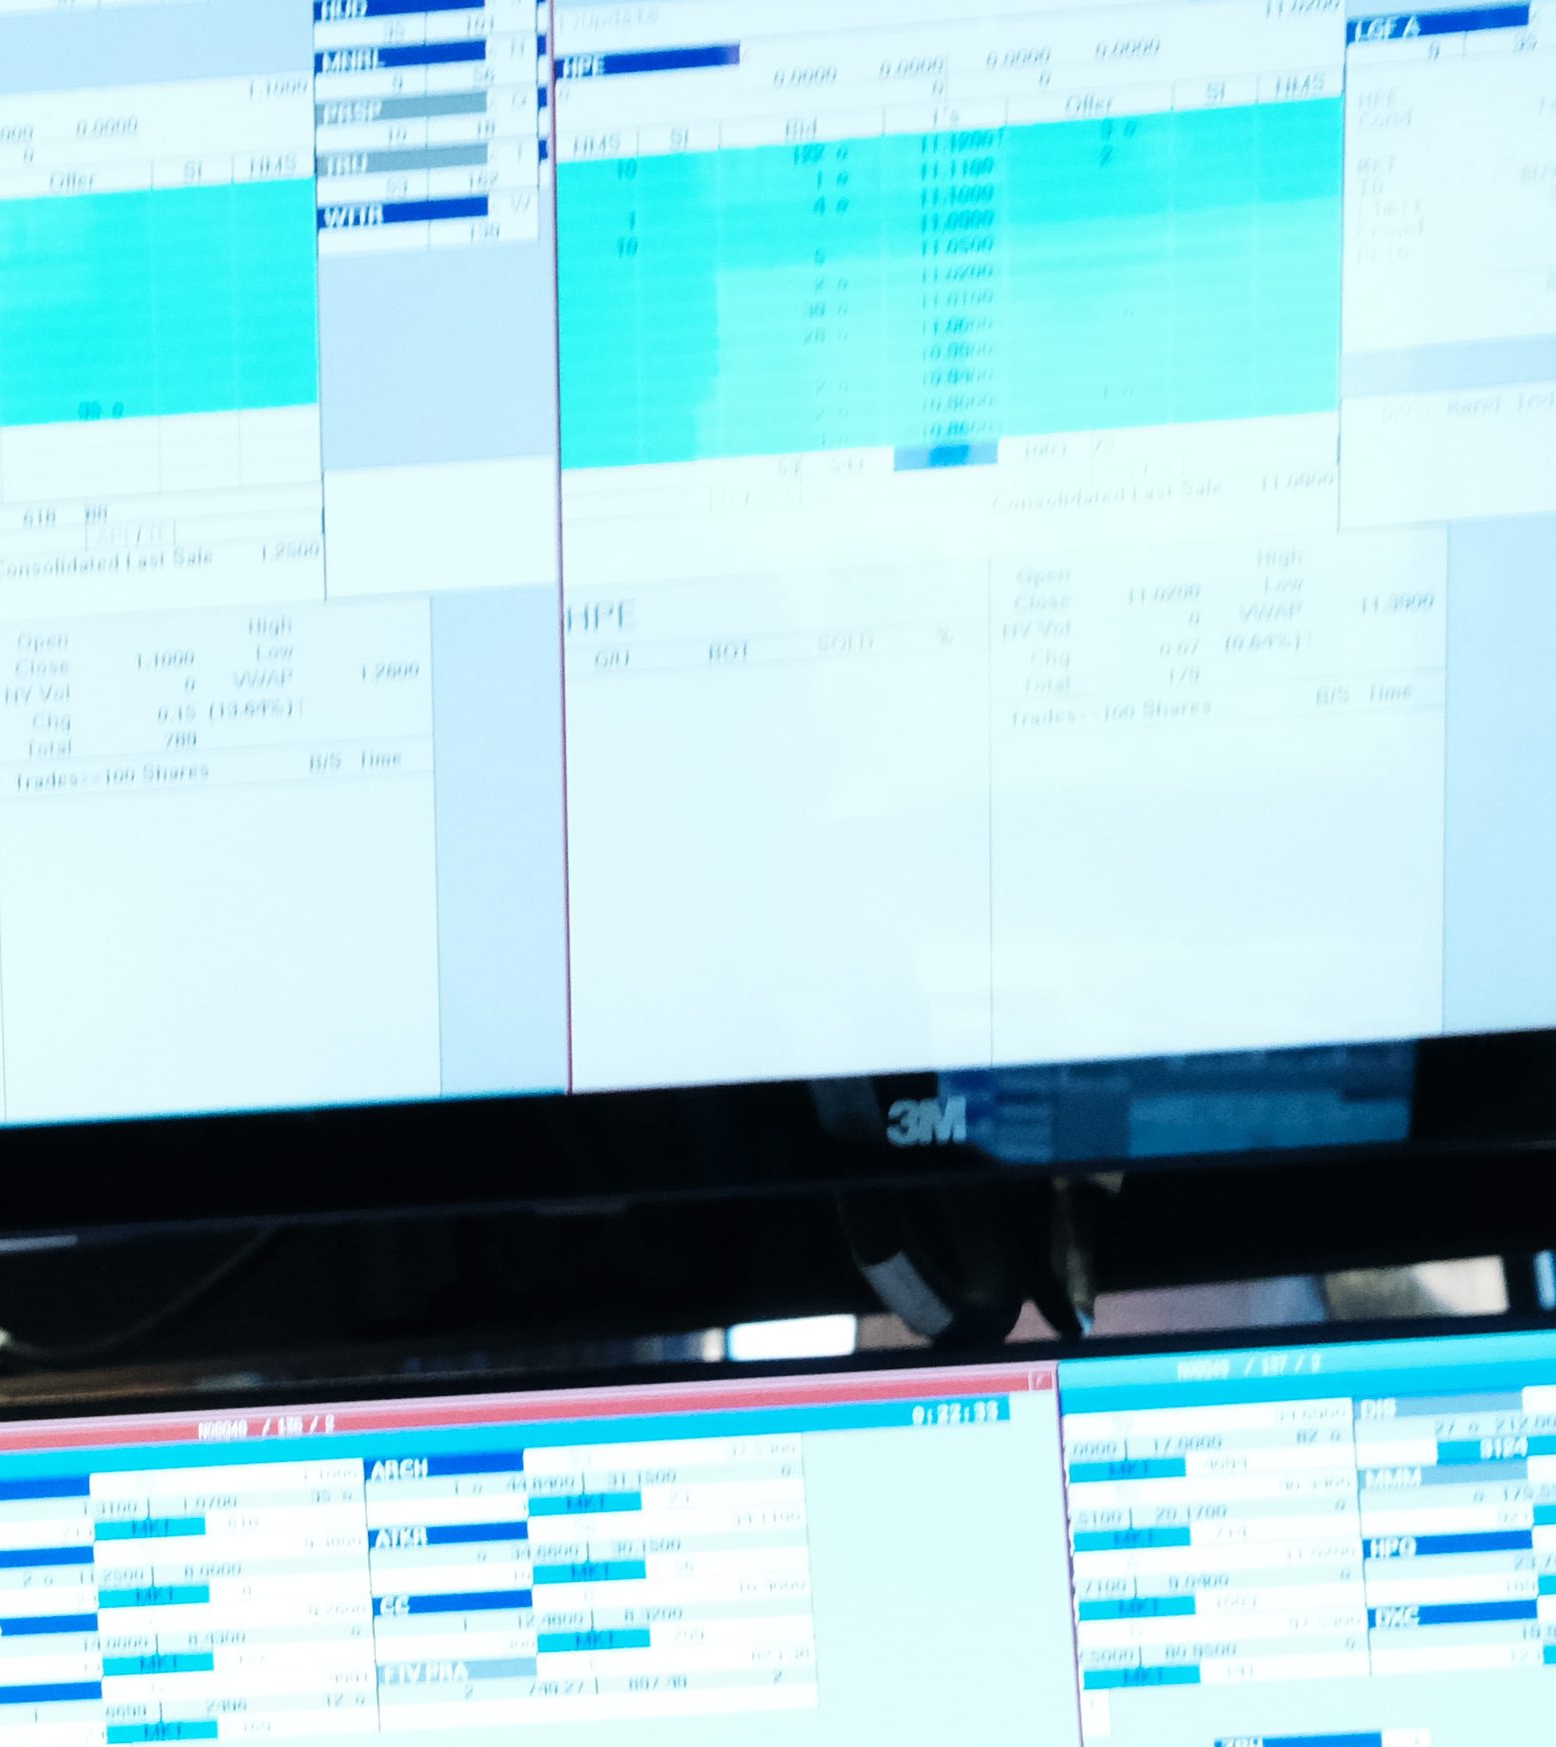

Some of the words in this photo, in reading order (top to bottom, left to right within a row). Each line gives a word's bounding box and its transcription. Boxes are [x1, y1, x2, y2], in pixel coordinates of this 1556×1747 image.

[126, 549, 164, 570] Last
[173, 546, 213, 567] Sale
[567, 599, 638, 632] HPE
[17, 632, 69, 652] Open
[249, 616, 292, 637] High
[15, 659, 69, 677] Close
[257, 644, 293, 661] Low
[28, 739, 72, 758] Total
[887, 1096, 966, 1145] 3M
[371, 1459, 428, 1481] ARCH
